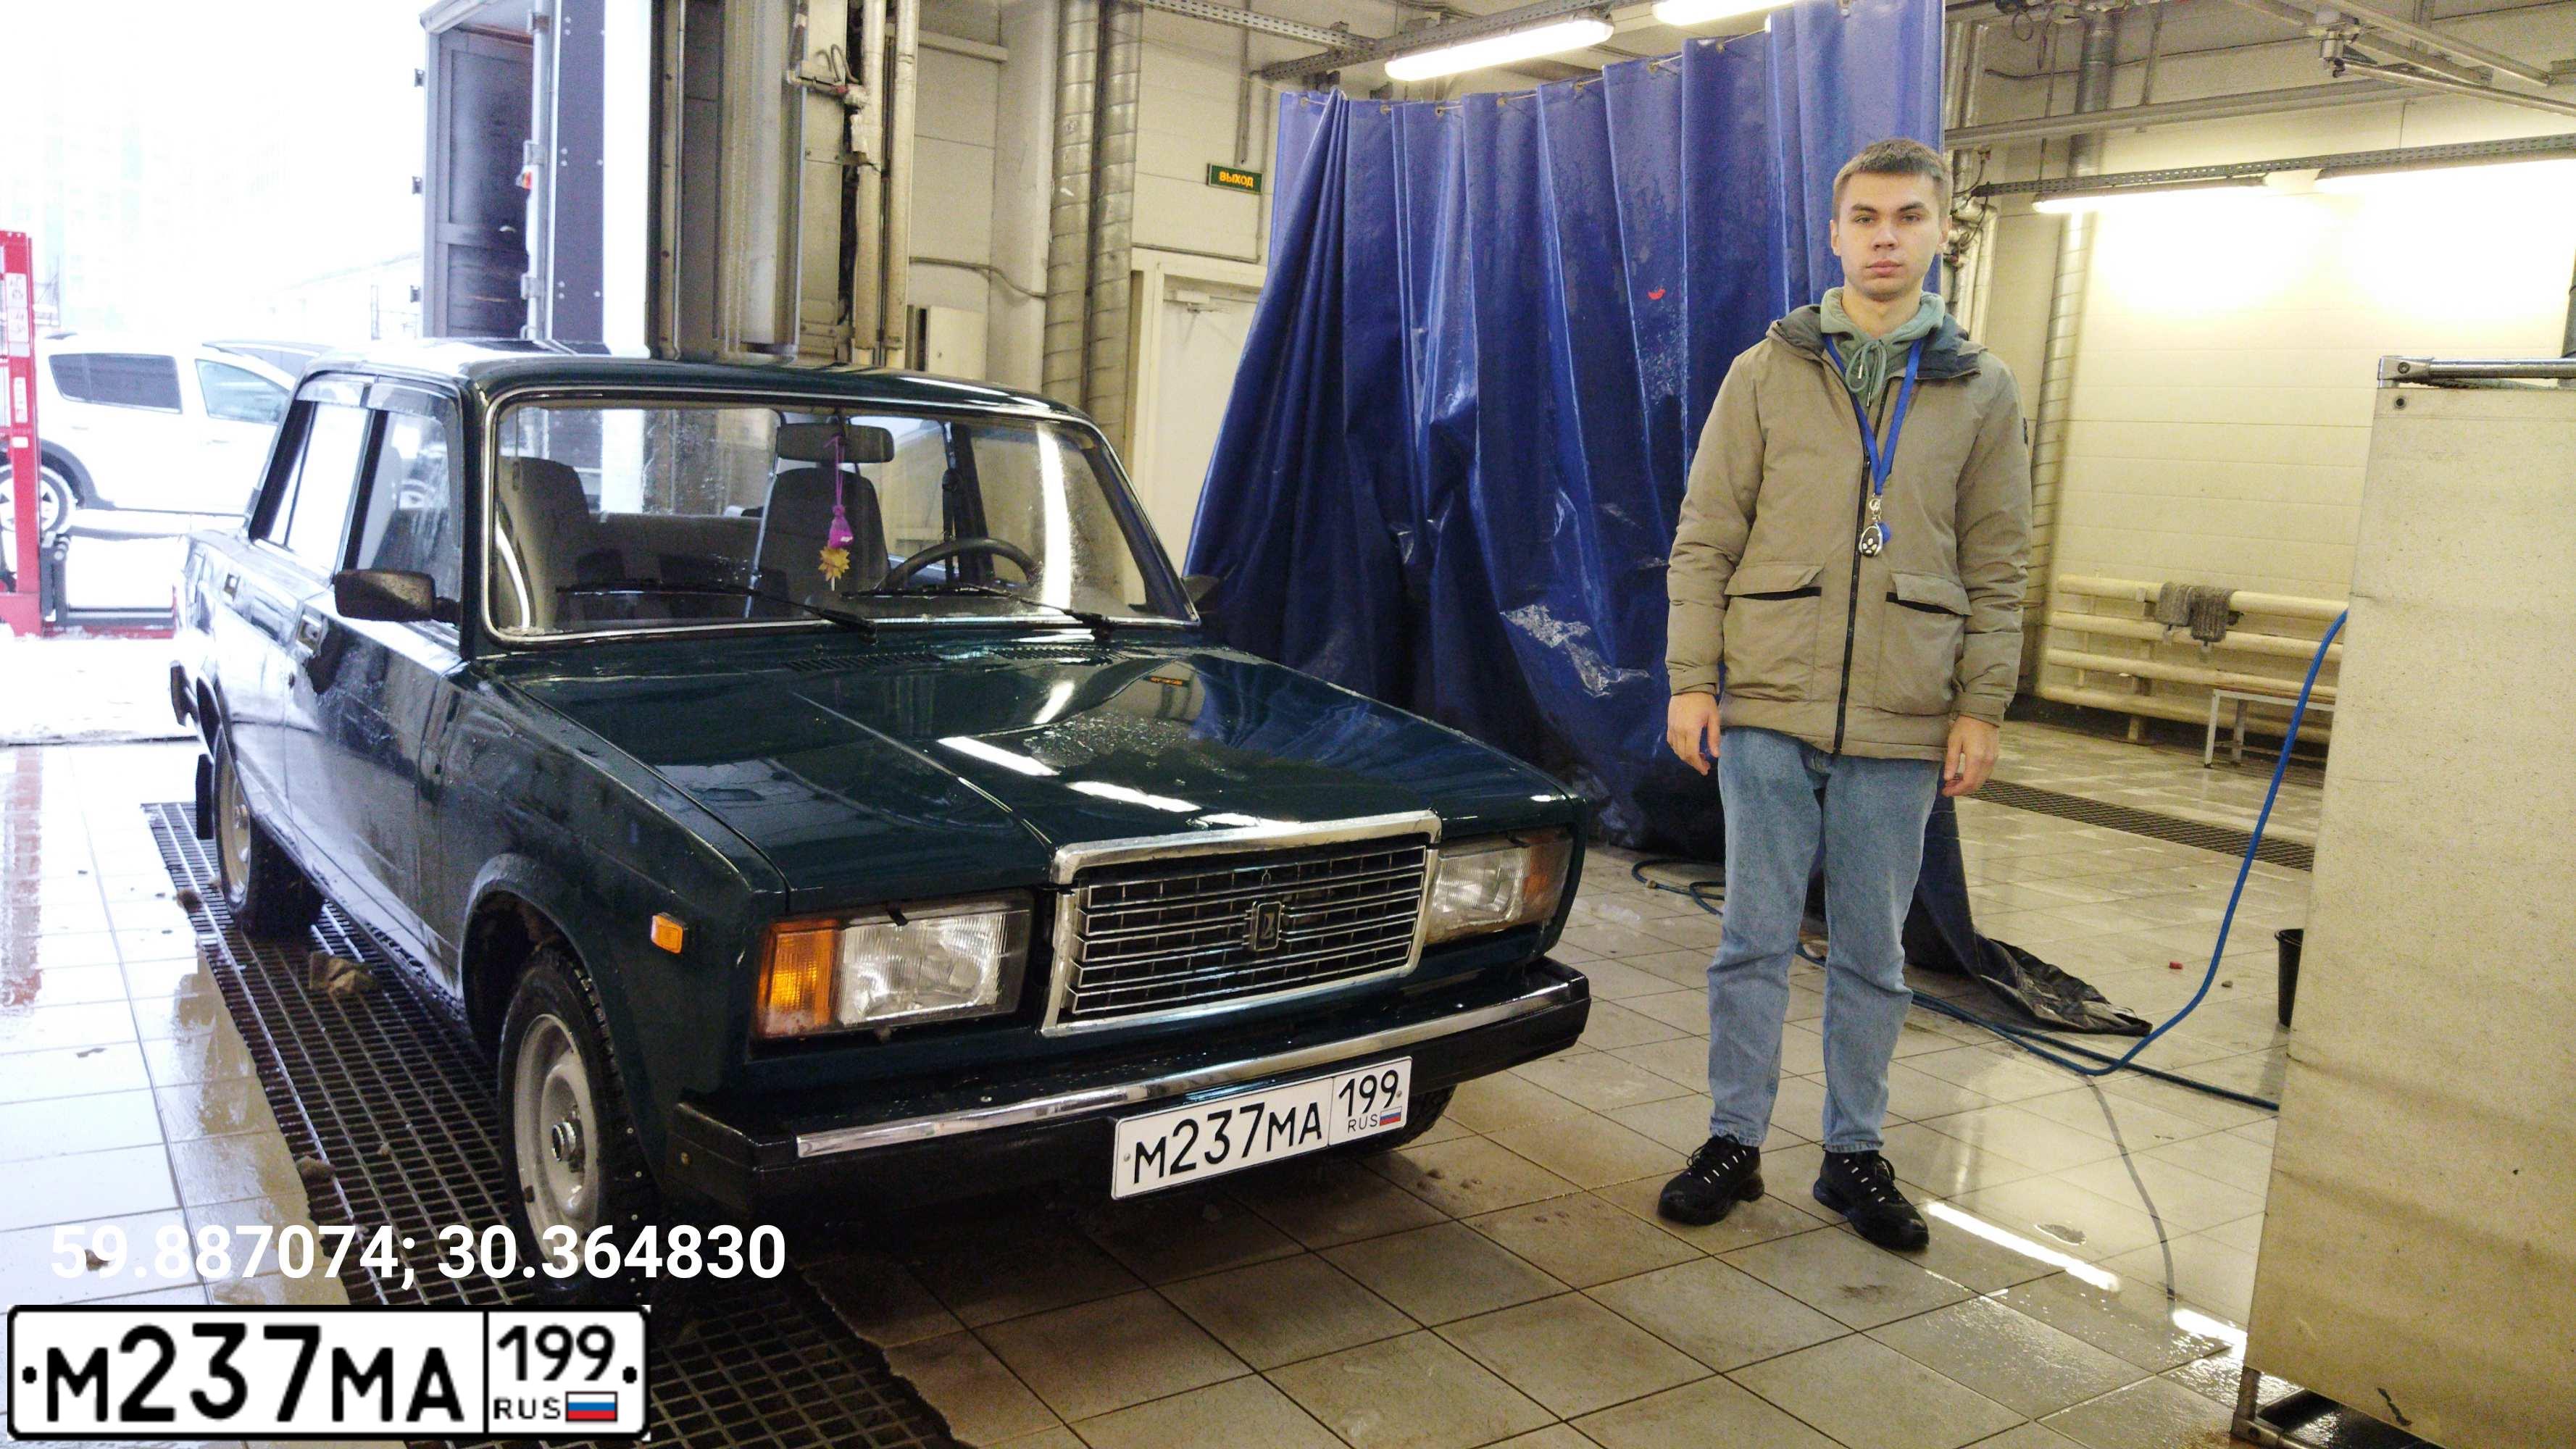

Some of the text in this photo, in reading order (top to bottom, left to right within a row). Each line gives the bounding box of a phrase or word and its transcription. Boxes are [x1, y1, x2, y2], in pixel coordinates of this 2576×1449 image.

[1219, 170, 1254, 188] ВЫХОД
[1338, 1069, 1399, 1117] 199
[1347, 1114, 1378, 1134] RUS
